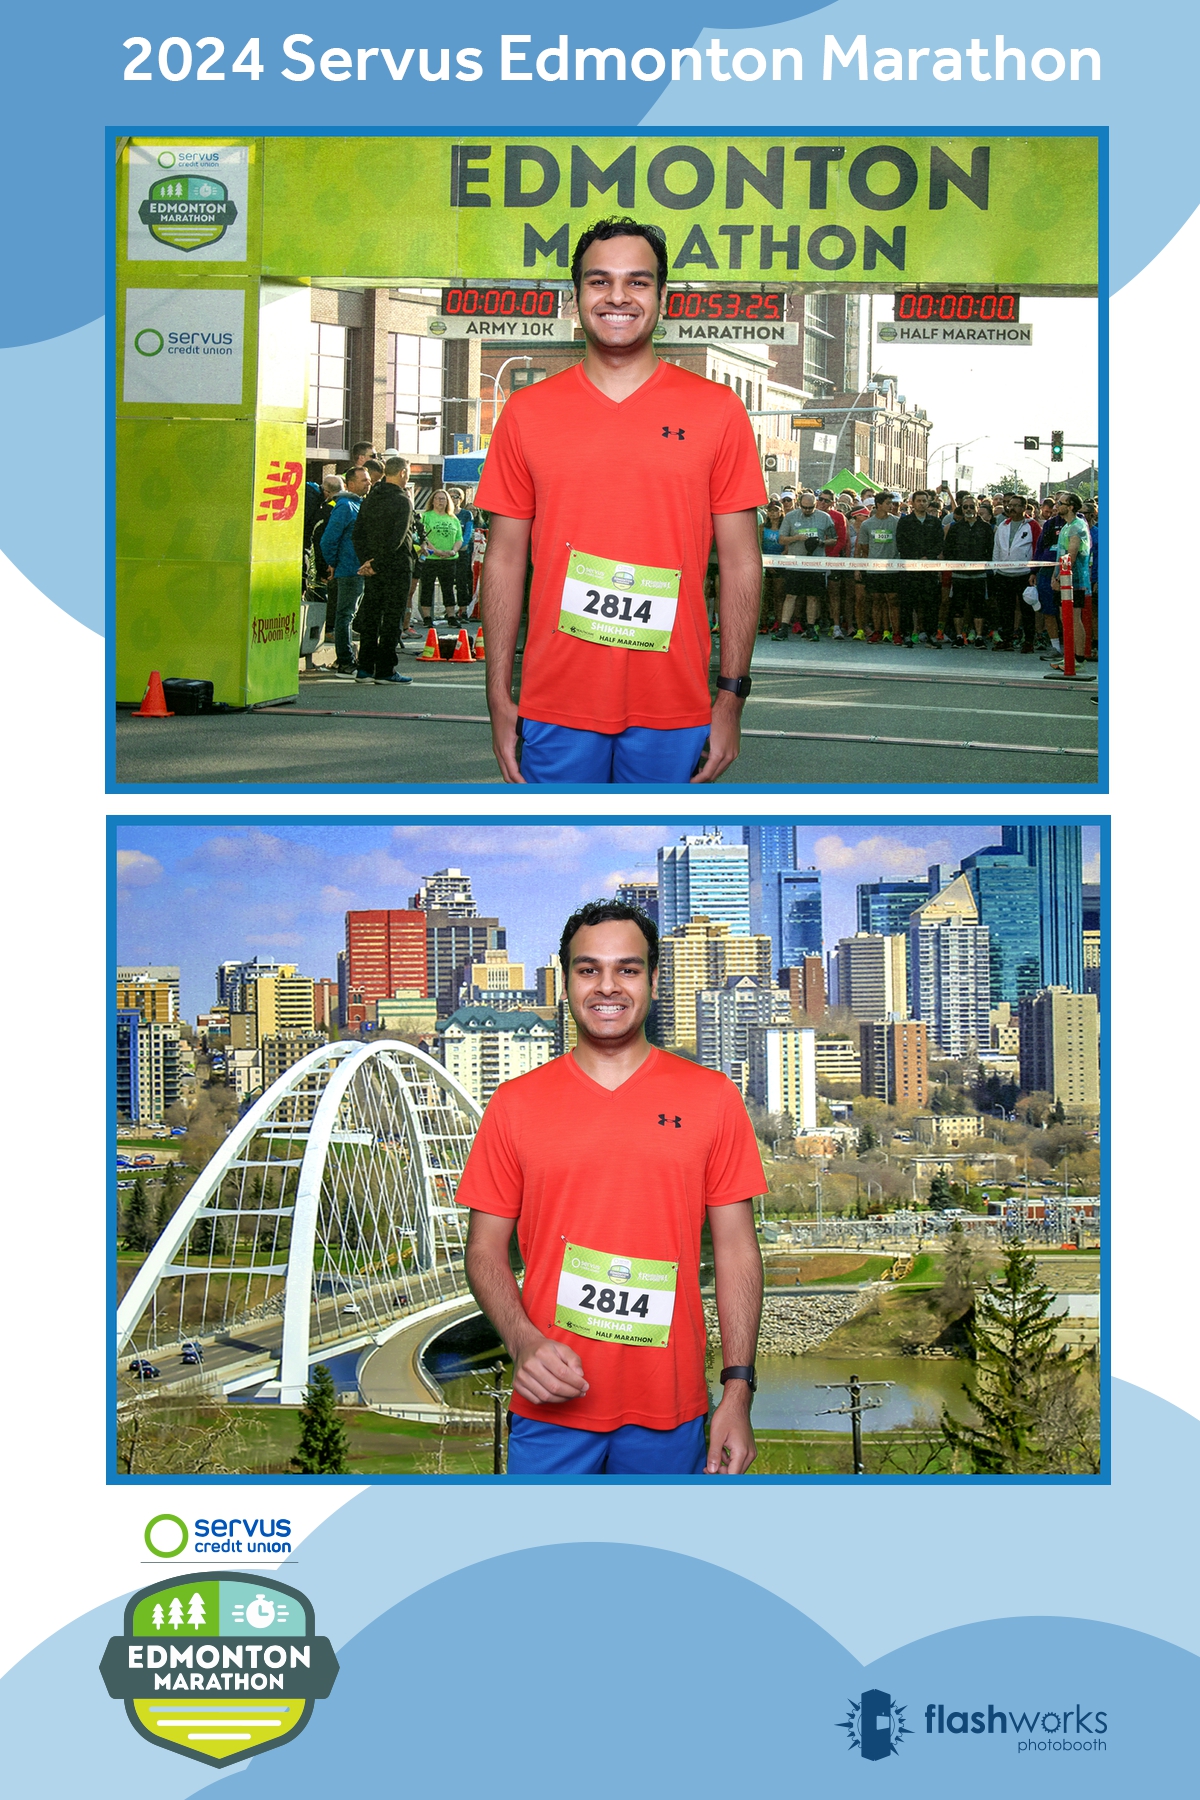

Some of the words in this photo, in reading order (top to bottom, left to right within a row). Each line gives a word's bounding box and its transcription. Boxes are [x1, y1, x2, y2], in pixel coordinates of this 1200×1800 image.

[178, 152, 220, 161] servus
[450, 145, 991, 211] EDMONTON
[149, 202, 227, 214] EDMONTON
[160, 214, 215, 222] MARATHON
[523, 222, 907, 271] MATHON
[465, 321, 518, 336] ARMY
[521, 322, 555, 337] 10K
[678, 325, 785, 340] MARATHON
[900, 328, 939, 340] HALF
[942, 328, 1031, 341] MARATHON
[168, 332, 233, 345] servus
[167, 345, 200, 355] credit
[202, 347, 233, 355] union
[582, 589, 653, 624] 2814
[257, 613, 291, 635] Running
[590, 621, 636, 638] SHIKHAR
[599, 634, 617, 644] HALF
[617, 638, 655, 649] MARATHON
[578, 1283, 650, 1318] 2814
[586, 1316, 634, 1332] SHIKHAR
[595, 1330, 613, 1340] HALF
[613, 1333, 654, 1344] MARATHON
